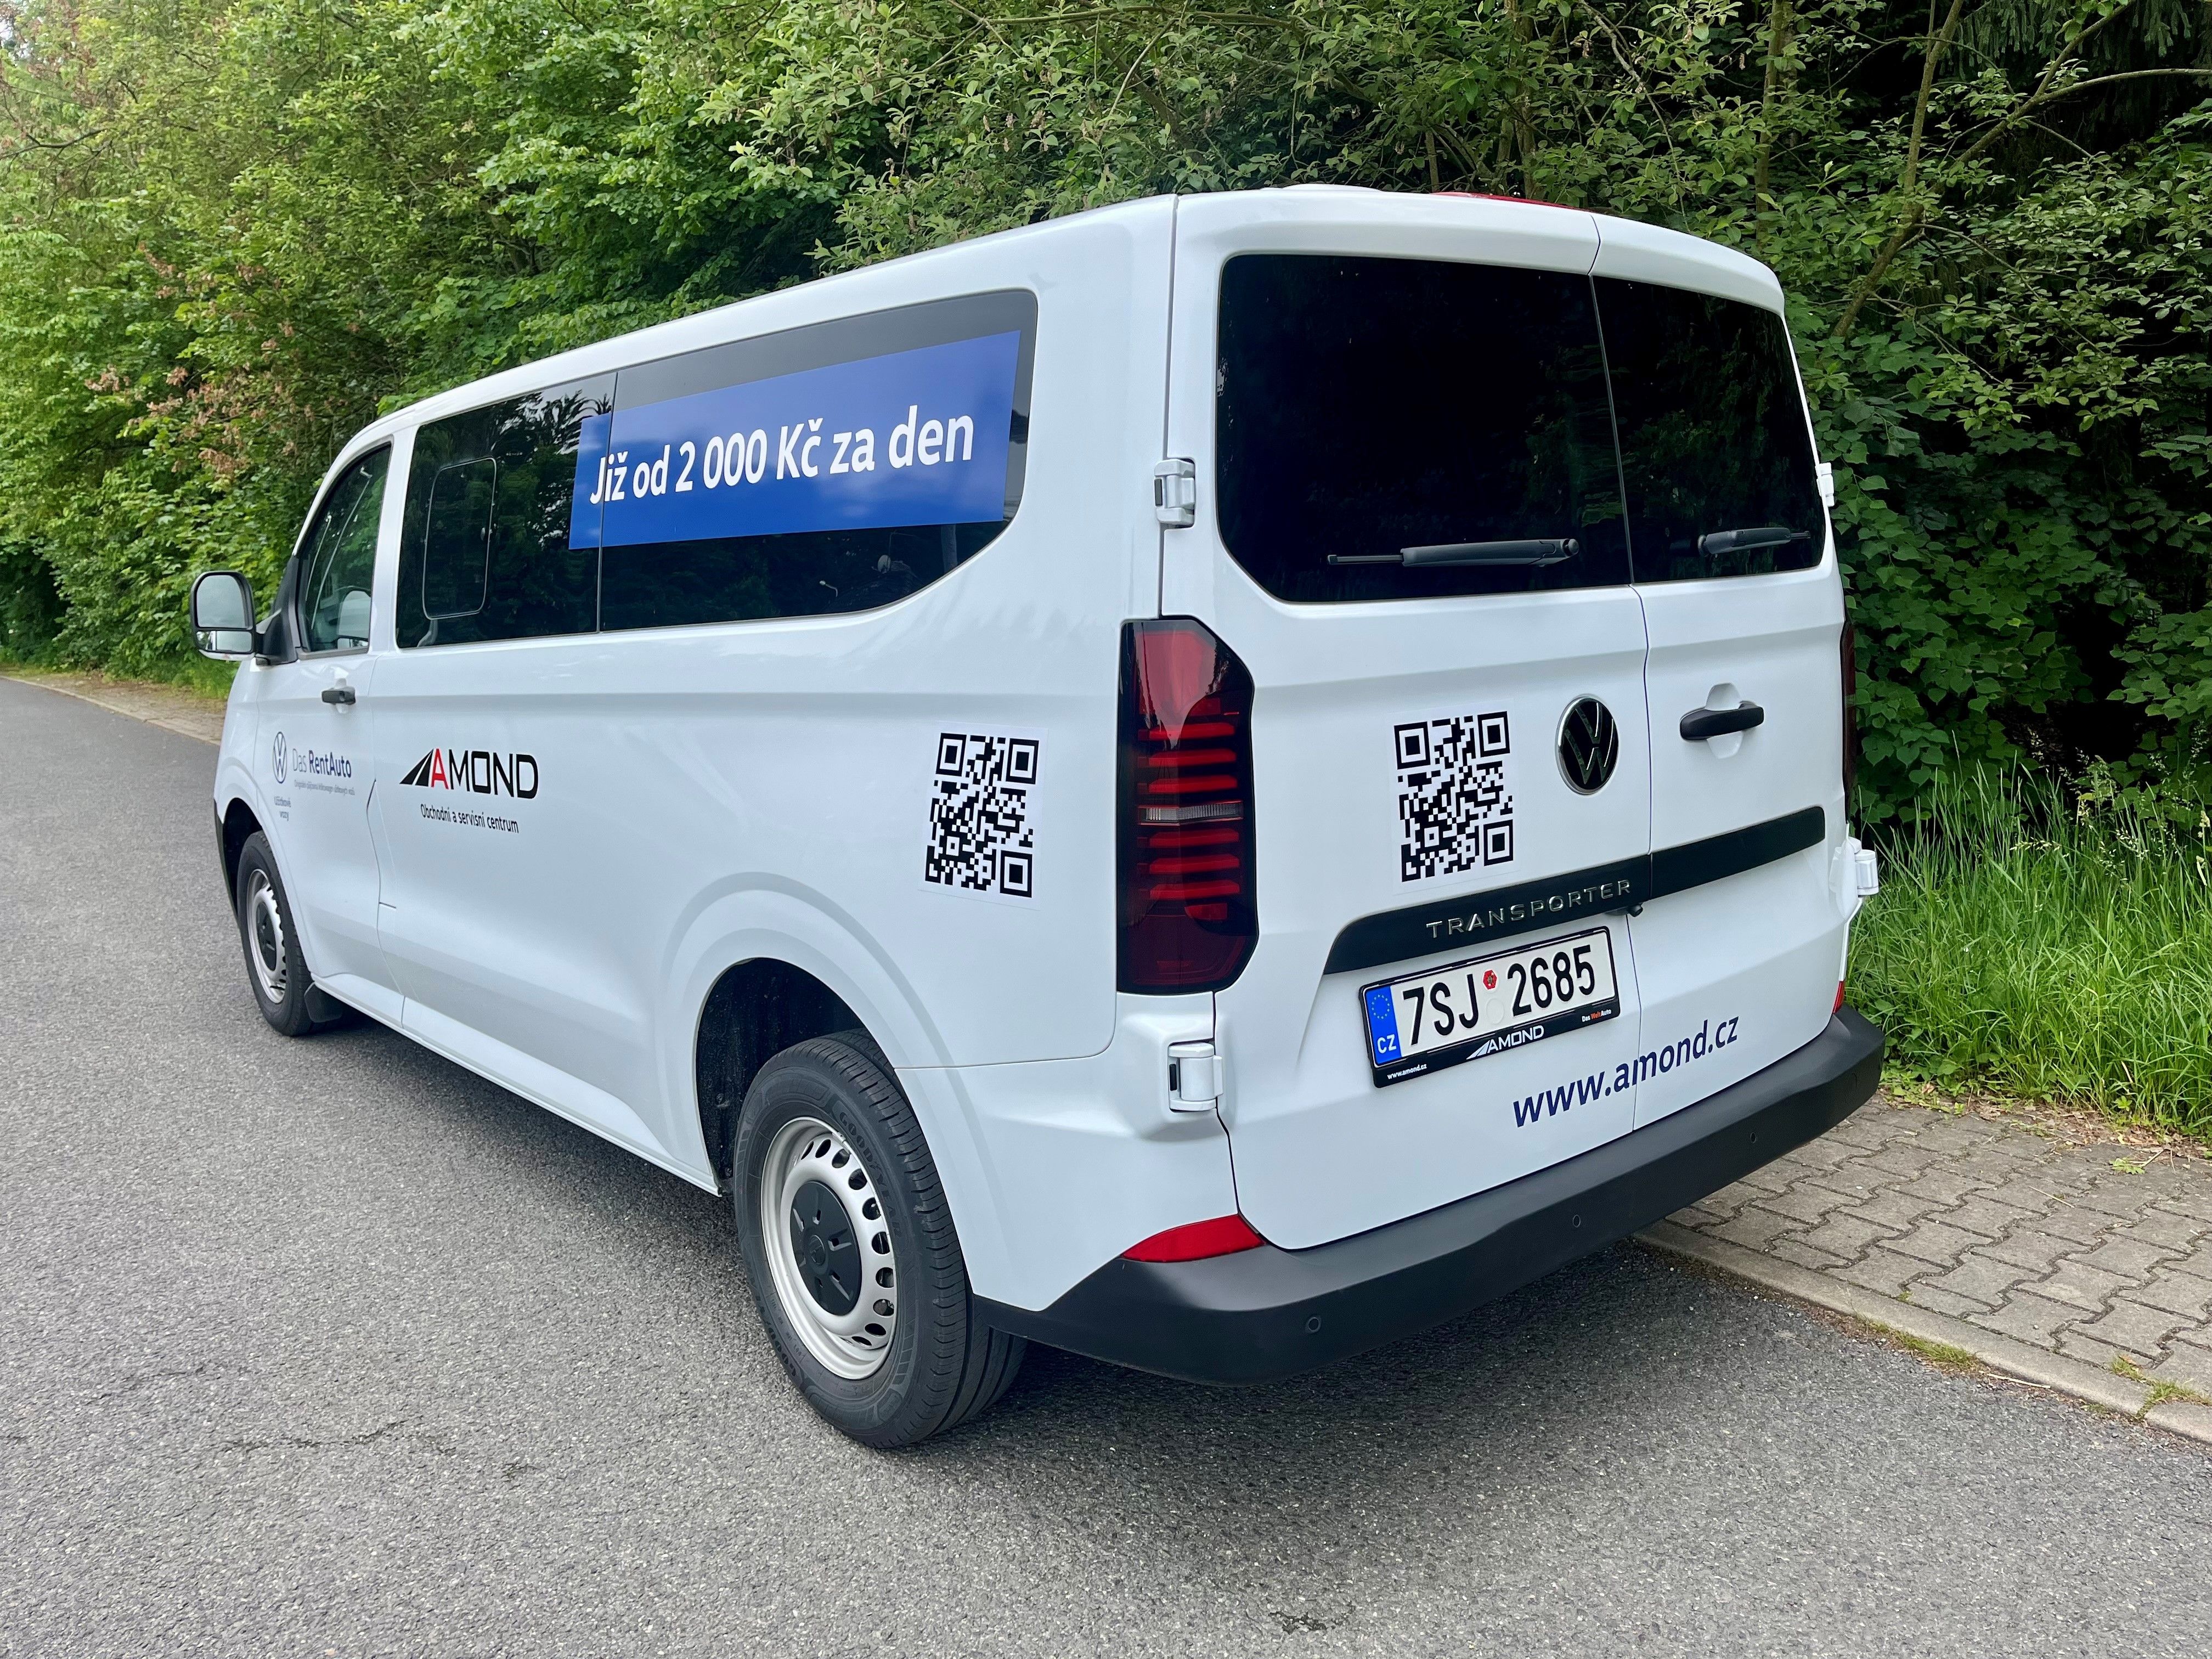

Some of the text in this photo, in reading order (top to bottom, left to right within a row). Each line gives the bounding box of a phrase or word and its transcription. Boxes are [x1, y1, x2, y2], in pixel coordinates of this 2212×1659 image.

[589, 404, 974, 505] Již od 2 000 Kč za den
[292, 748, 352, 778] Das RentAuto
[431, 748, 539, 799] AMOND
[452, 811, 458, 823] a
[487, 816, 520, 834] centrum
[1426, 879, 1631, 939] TRANSPORTER
[1402, 944, 1595, 1046] 7SJ 2685
[1377, 1034, 1397, 1054] CZ
[1487, 1025, 1544, 1054] AMOND
[1387, 1063, 1427, 1080] www.amond.cz
[1512, 1015, 1740, 1128] www.amond.cz
